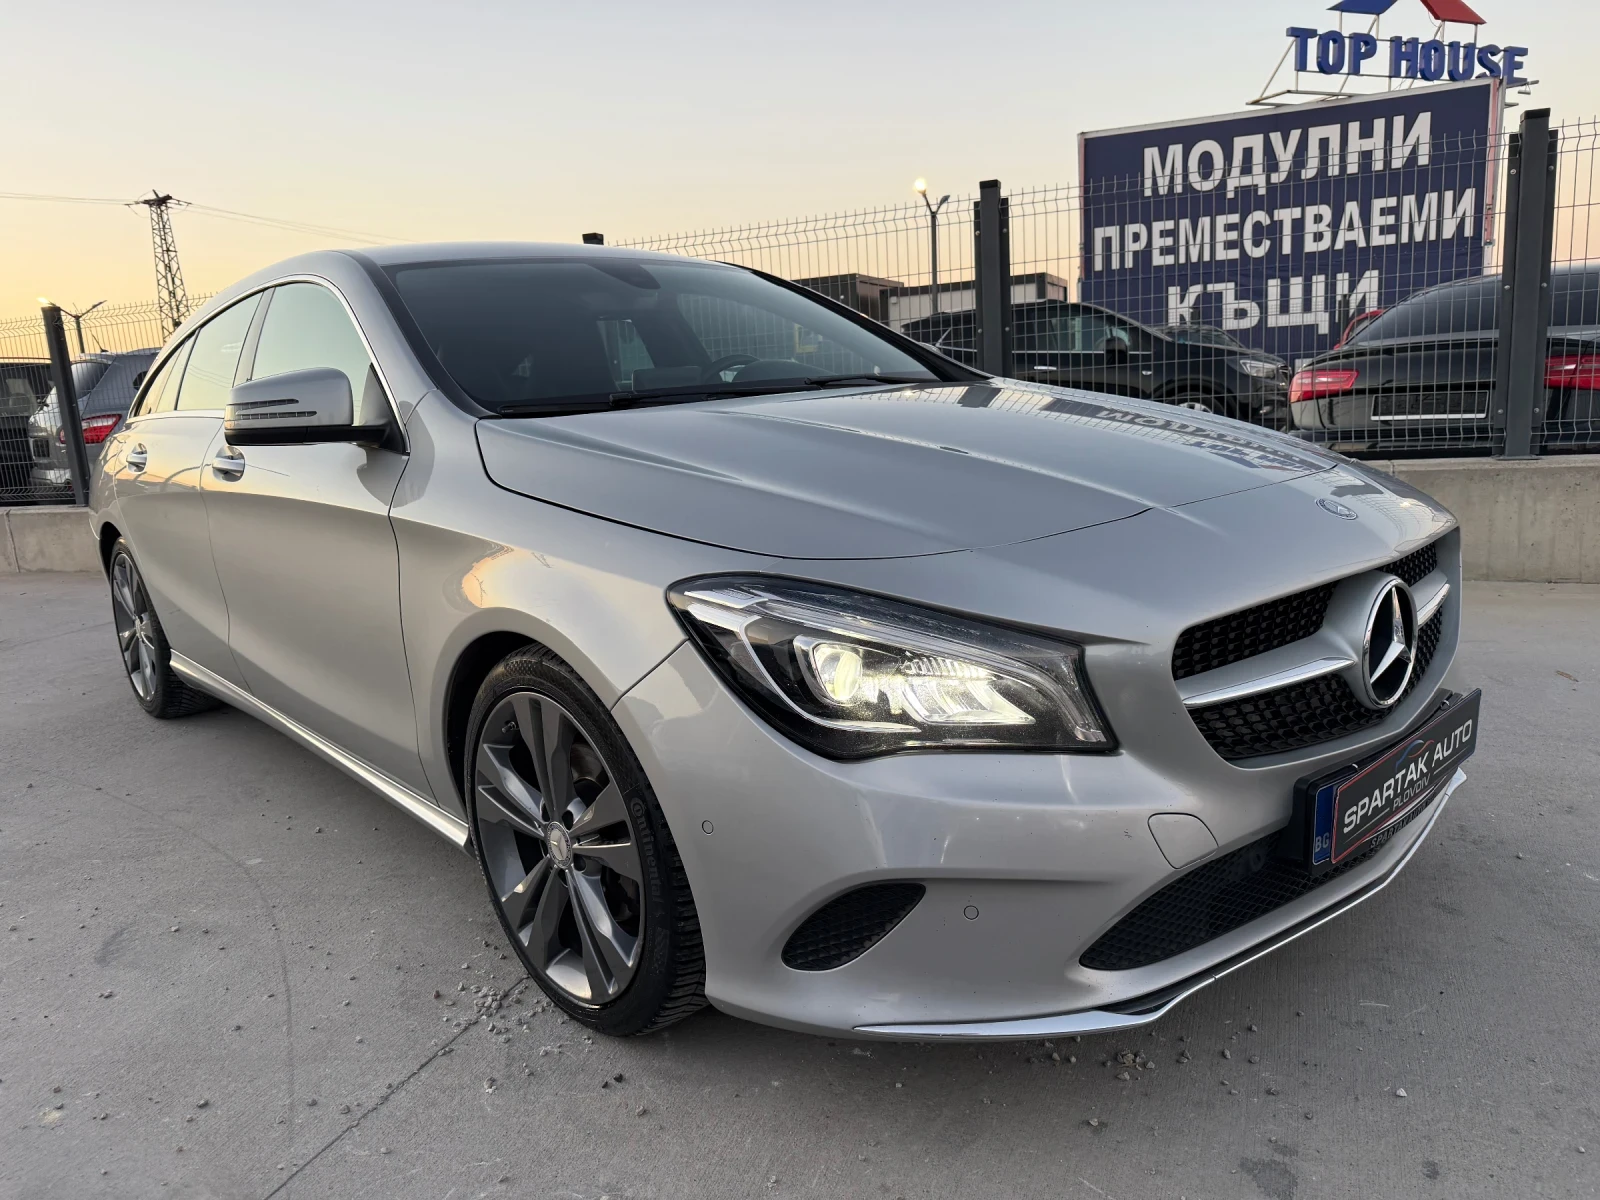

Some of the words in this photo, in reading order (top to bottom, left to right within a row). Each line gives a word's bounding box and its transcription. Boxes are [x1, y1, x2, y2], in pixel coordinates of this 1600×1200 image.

[1286, 27, 1377, 75] TOP
[1389, 35, 1529, 87] HOUSE
[1143, 111, 1432, 199] МОДУЛНИ
[1093, 187, 1477, 272] ПРЕМЕСТВАЕМИ
[1167, 269, 1380, 335] КЪЩИ
[1343, 751, 1430, 834] SPARTAK
[1431, 718, 1473, 768] AUTO
[1392, 772, 1431, 812] PLOVDIV
[1314, 832, 1330, 852] BG
